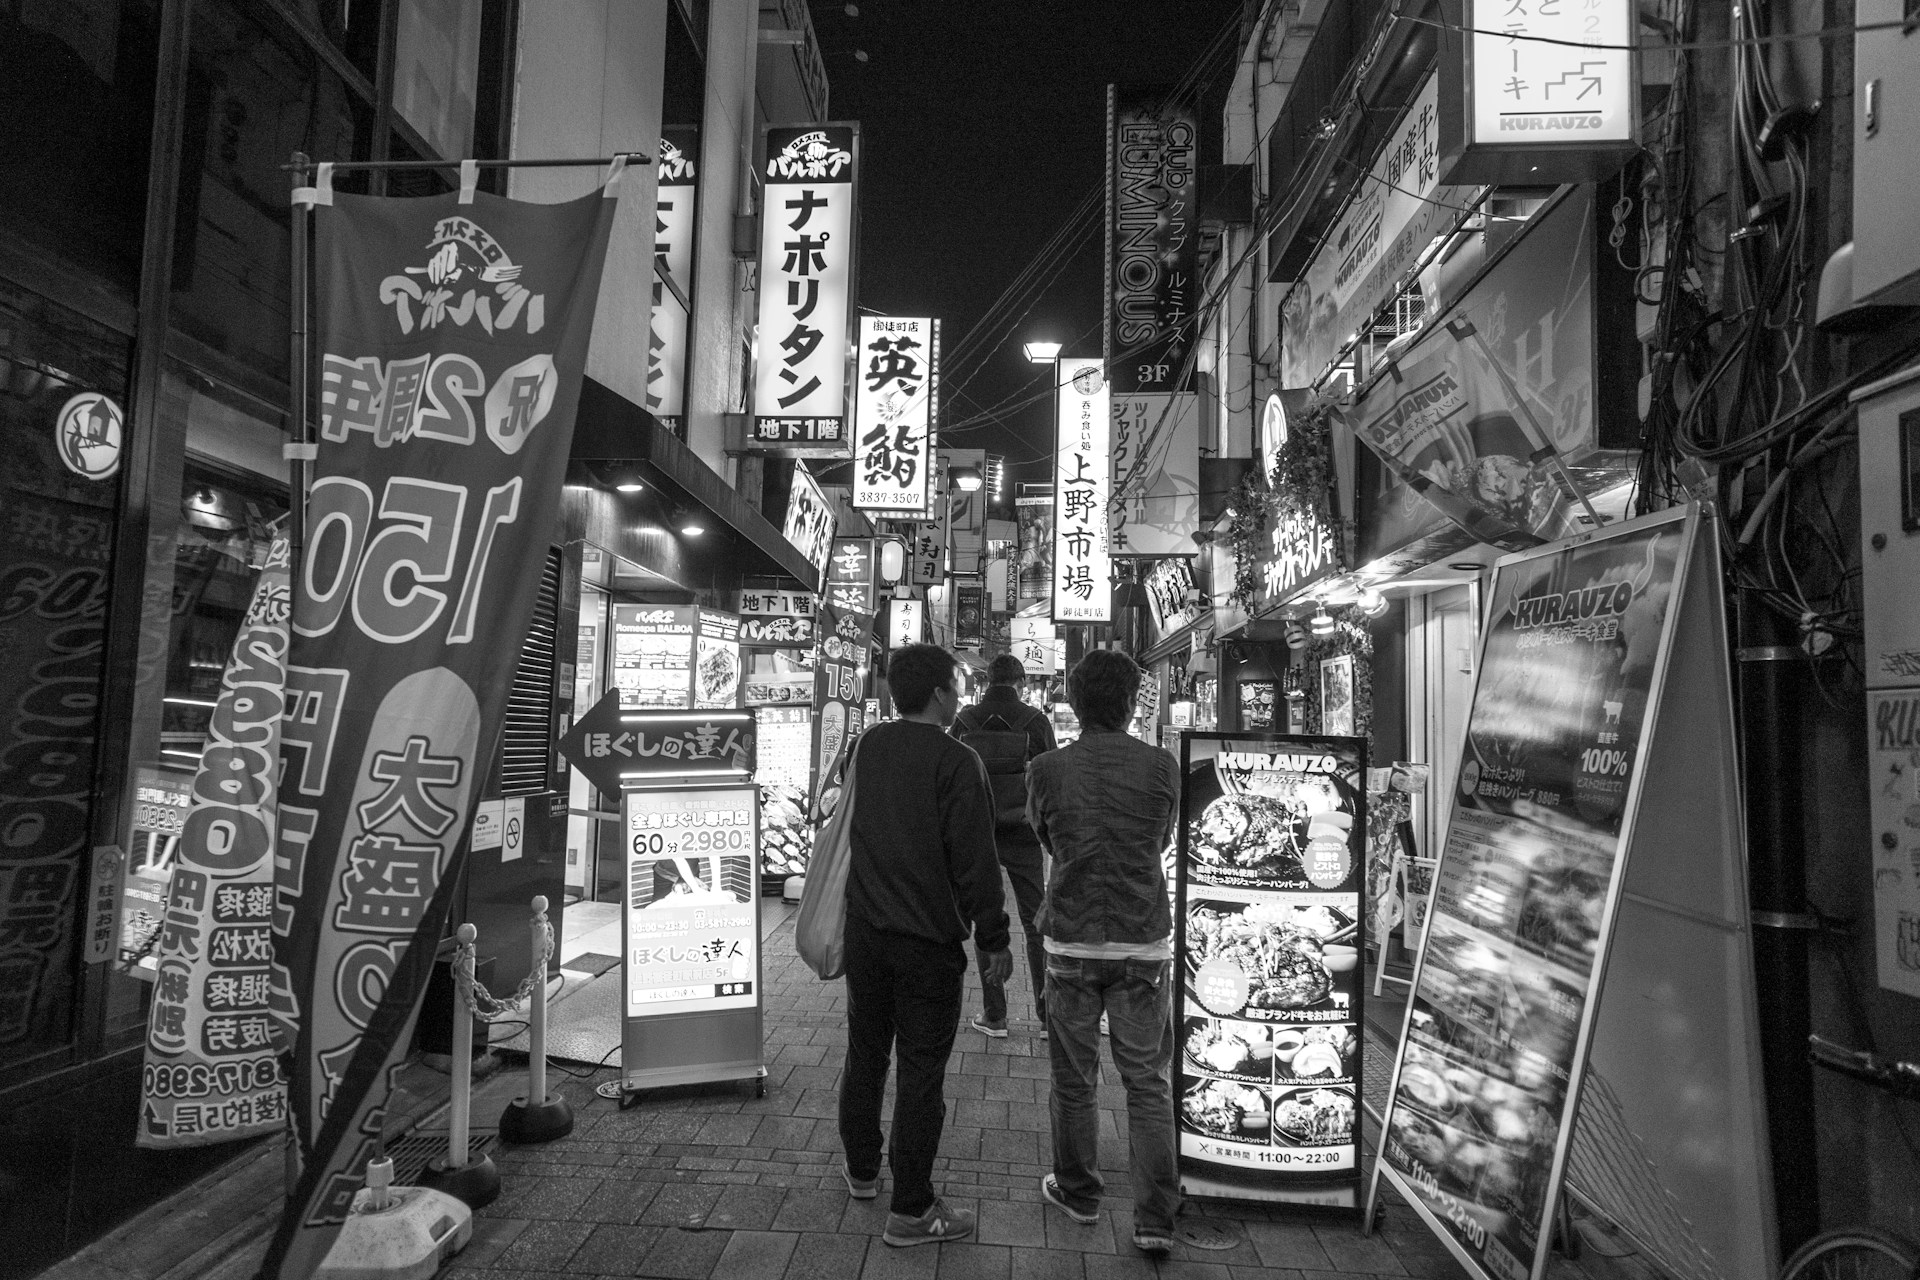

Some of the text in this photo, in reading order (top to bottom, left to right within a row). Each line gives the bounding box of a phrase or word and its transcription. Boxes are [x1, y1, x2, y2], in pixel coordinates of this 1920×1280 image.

[1500, 115, 1603, 131] KURAUZO
[766, 151, 852, 180] バルボア
[1166, 122, 1194, 189] Club
[1117, 123, 1159, 345] LUMINOUS
[1169, 200, 1188, 252] クラブ
[1336, 221, 1381, 289] KURAUZO
[777, 190, 831, 409] ナポリタン
[1168, 271, 1188, 343] ルミナス
[872, 320, 920, 334] 御徒町店
[1137, 364, 1170, 383] 3F
[758, 418, 840, 441] 地下1階
[1080, 401, 1092, 452] 呑み食い処
[1112, 402, 1128, 550] ジャックトマメノキ
[859, 491, 921, 505] 3837-3507
[1062, 452, 1098, 602] 上野市場
[742, 594, 811, 614] 地下1階
[1062, 606, 1104, 618] 御徒町店
[1513, 579, 1634, 630] KURAUZO
[656, 624, 694, 634] BALBOA
[583, 720, 745, 762] ほぐしの達人
[1218, 751, 1338, 773] KURAUZO
[1581, 747, 1628, 777] 100%
[631, 809, 751, 830] 全身ほぐし専門店
[632, 833, 664, 855] 60
[667, 841, 678, 853] 分
[632, 938, 744, 966] ほぐしの達人
[715, 967, 730, 978] 5F
